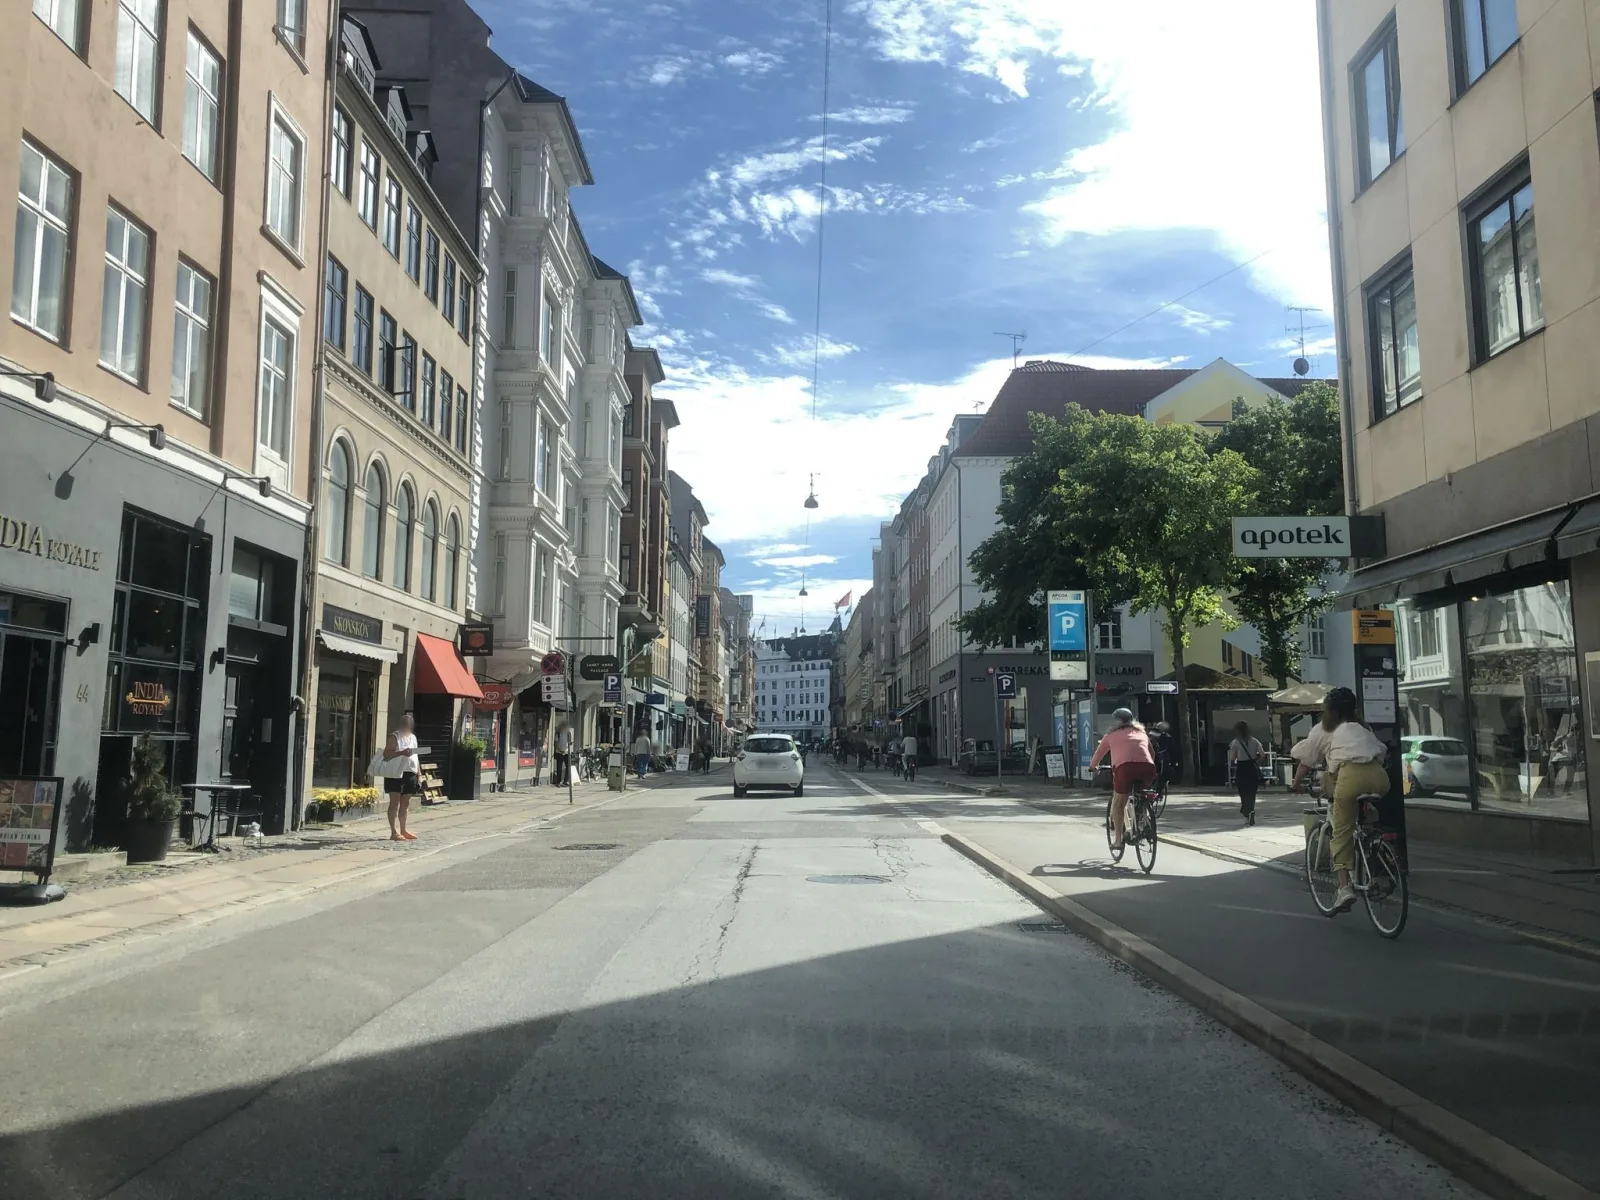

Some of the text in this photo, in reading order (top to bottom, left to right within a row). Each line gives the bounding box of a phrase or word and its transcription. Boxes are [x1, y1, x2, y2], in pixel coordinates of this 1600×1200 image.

[0, 515, 103, 571] DIA ROYALE
[1241, 525, 1344, 550] apotek
[1062, 616, 1075, 635] P
[999, 666, 1142, 676] SPAREKAS JYLLAND
[134, 682, 165, 700] INDIA
[608, 676, 618, 690] P
[1002, 678, 1011, 691] P
[76, 683, 88, 703] 44
[133, 704, 163, 716] ROYALE
